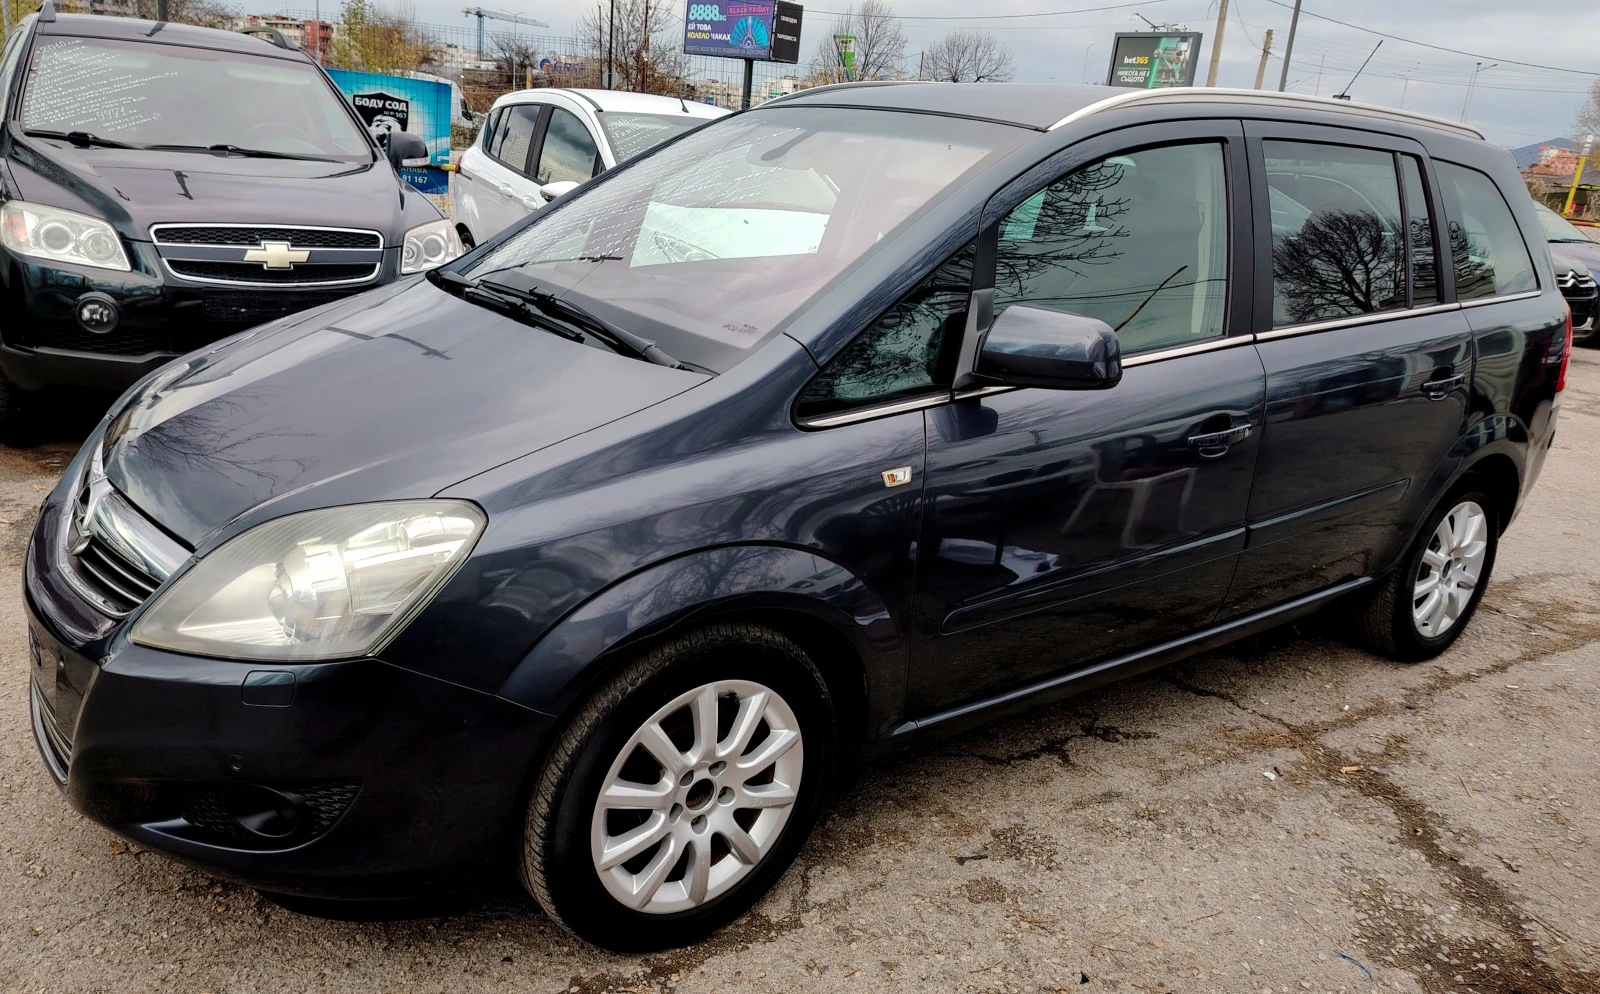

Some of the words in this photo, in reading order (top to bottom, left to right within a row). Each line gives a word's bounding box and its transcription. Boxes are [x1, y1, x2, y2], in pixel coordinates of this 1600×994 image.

[749, 6, 770, 14] FRIDAY
[710, 32, 732, 41] ЧАКАХ
[40, 40, 67, 54] 2010
[1124, 56, 1149, 64] bet365
[355, 97, 384, 109] БОДУ
[385, 101, 407, 112] СОД
[96, 106, 128, 122] 9971
[402, 174, 411, 183] 91
[413, 175, 428, 184] 167
